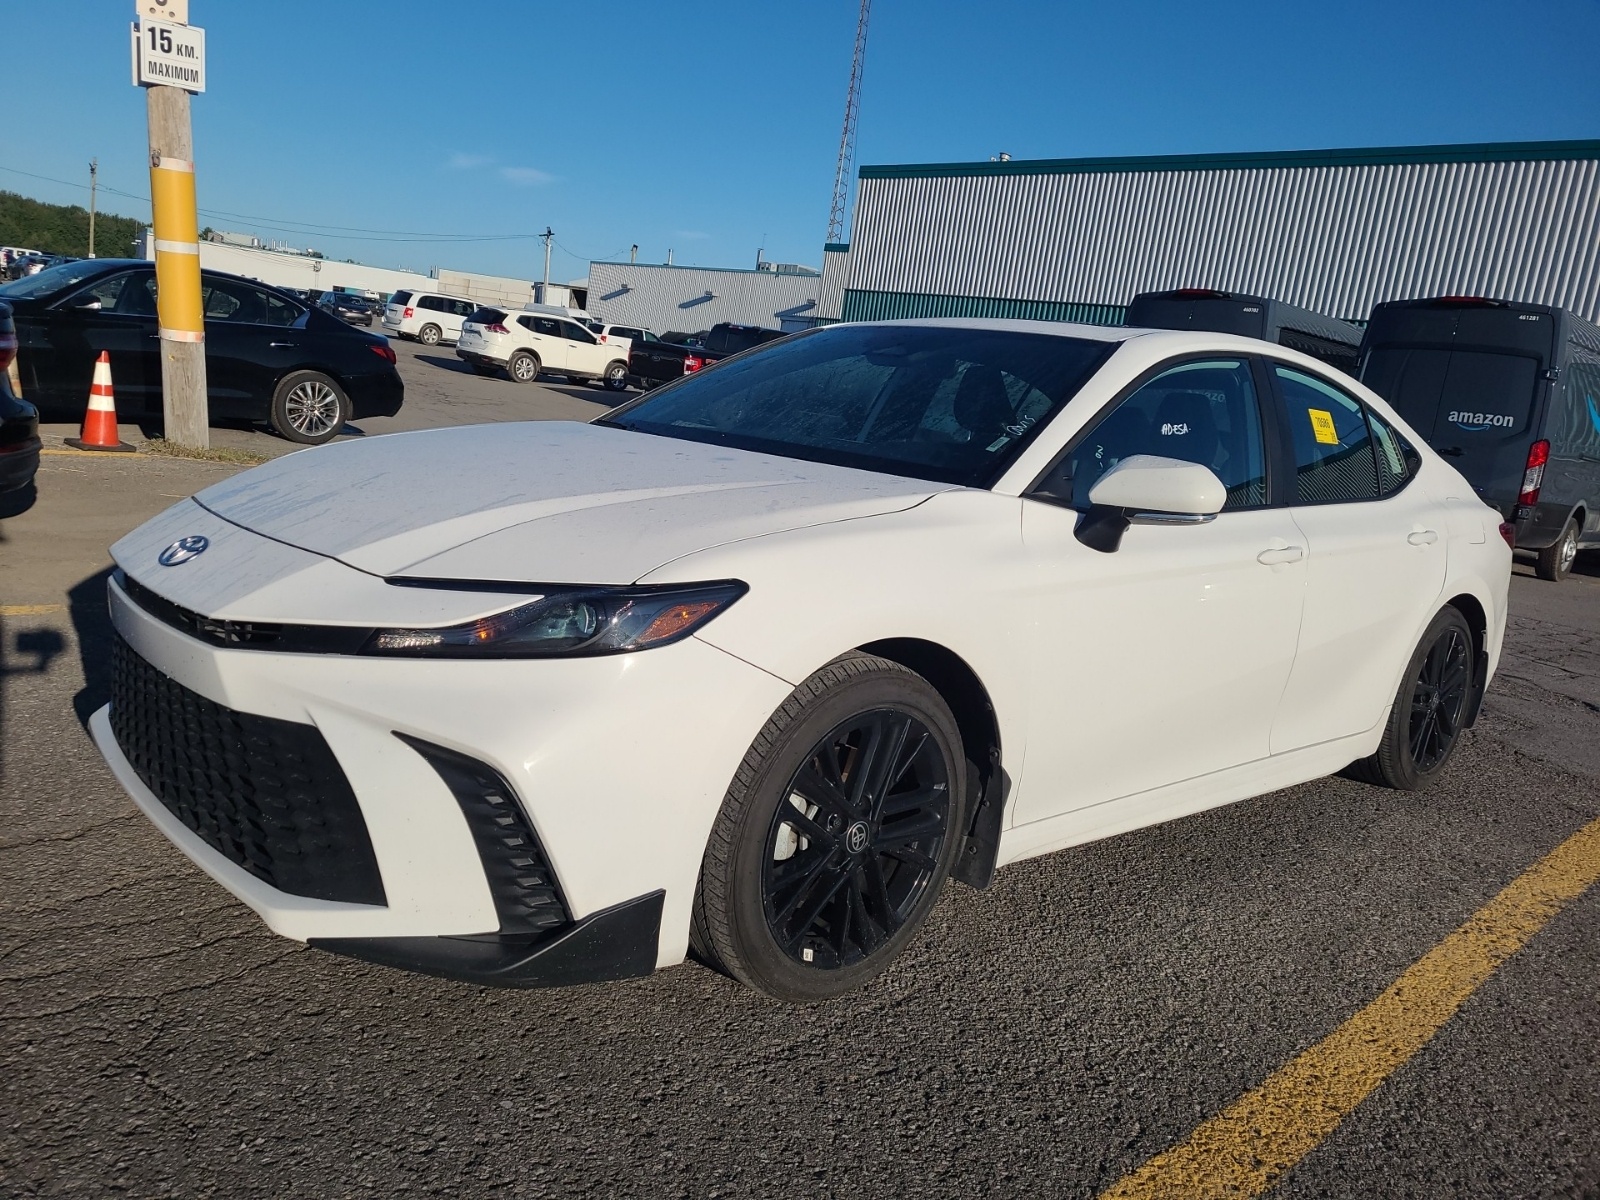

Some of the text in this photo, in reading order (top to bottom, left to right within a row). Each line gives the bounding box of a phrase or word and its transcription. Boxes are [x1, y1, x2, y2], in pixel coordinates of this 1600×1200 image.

[147, 26, 199, 60] 15 KM.
[148, 60, 199, 84] MAXIMUM
[1447, 410, 1514, 428] amazon
